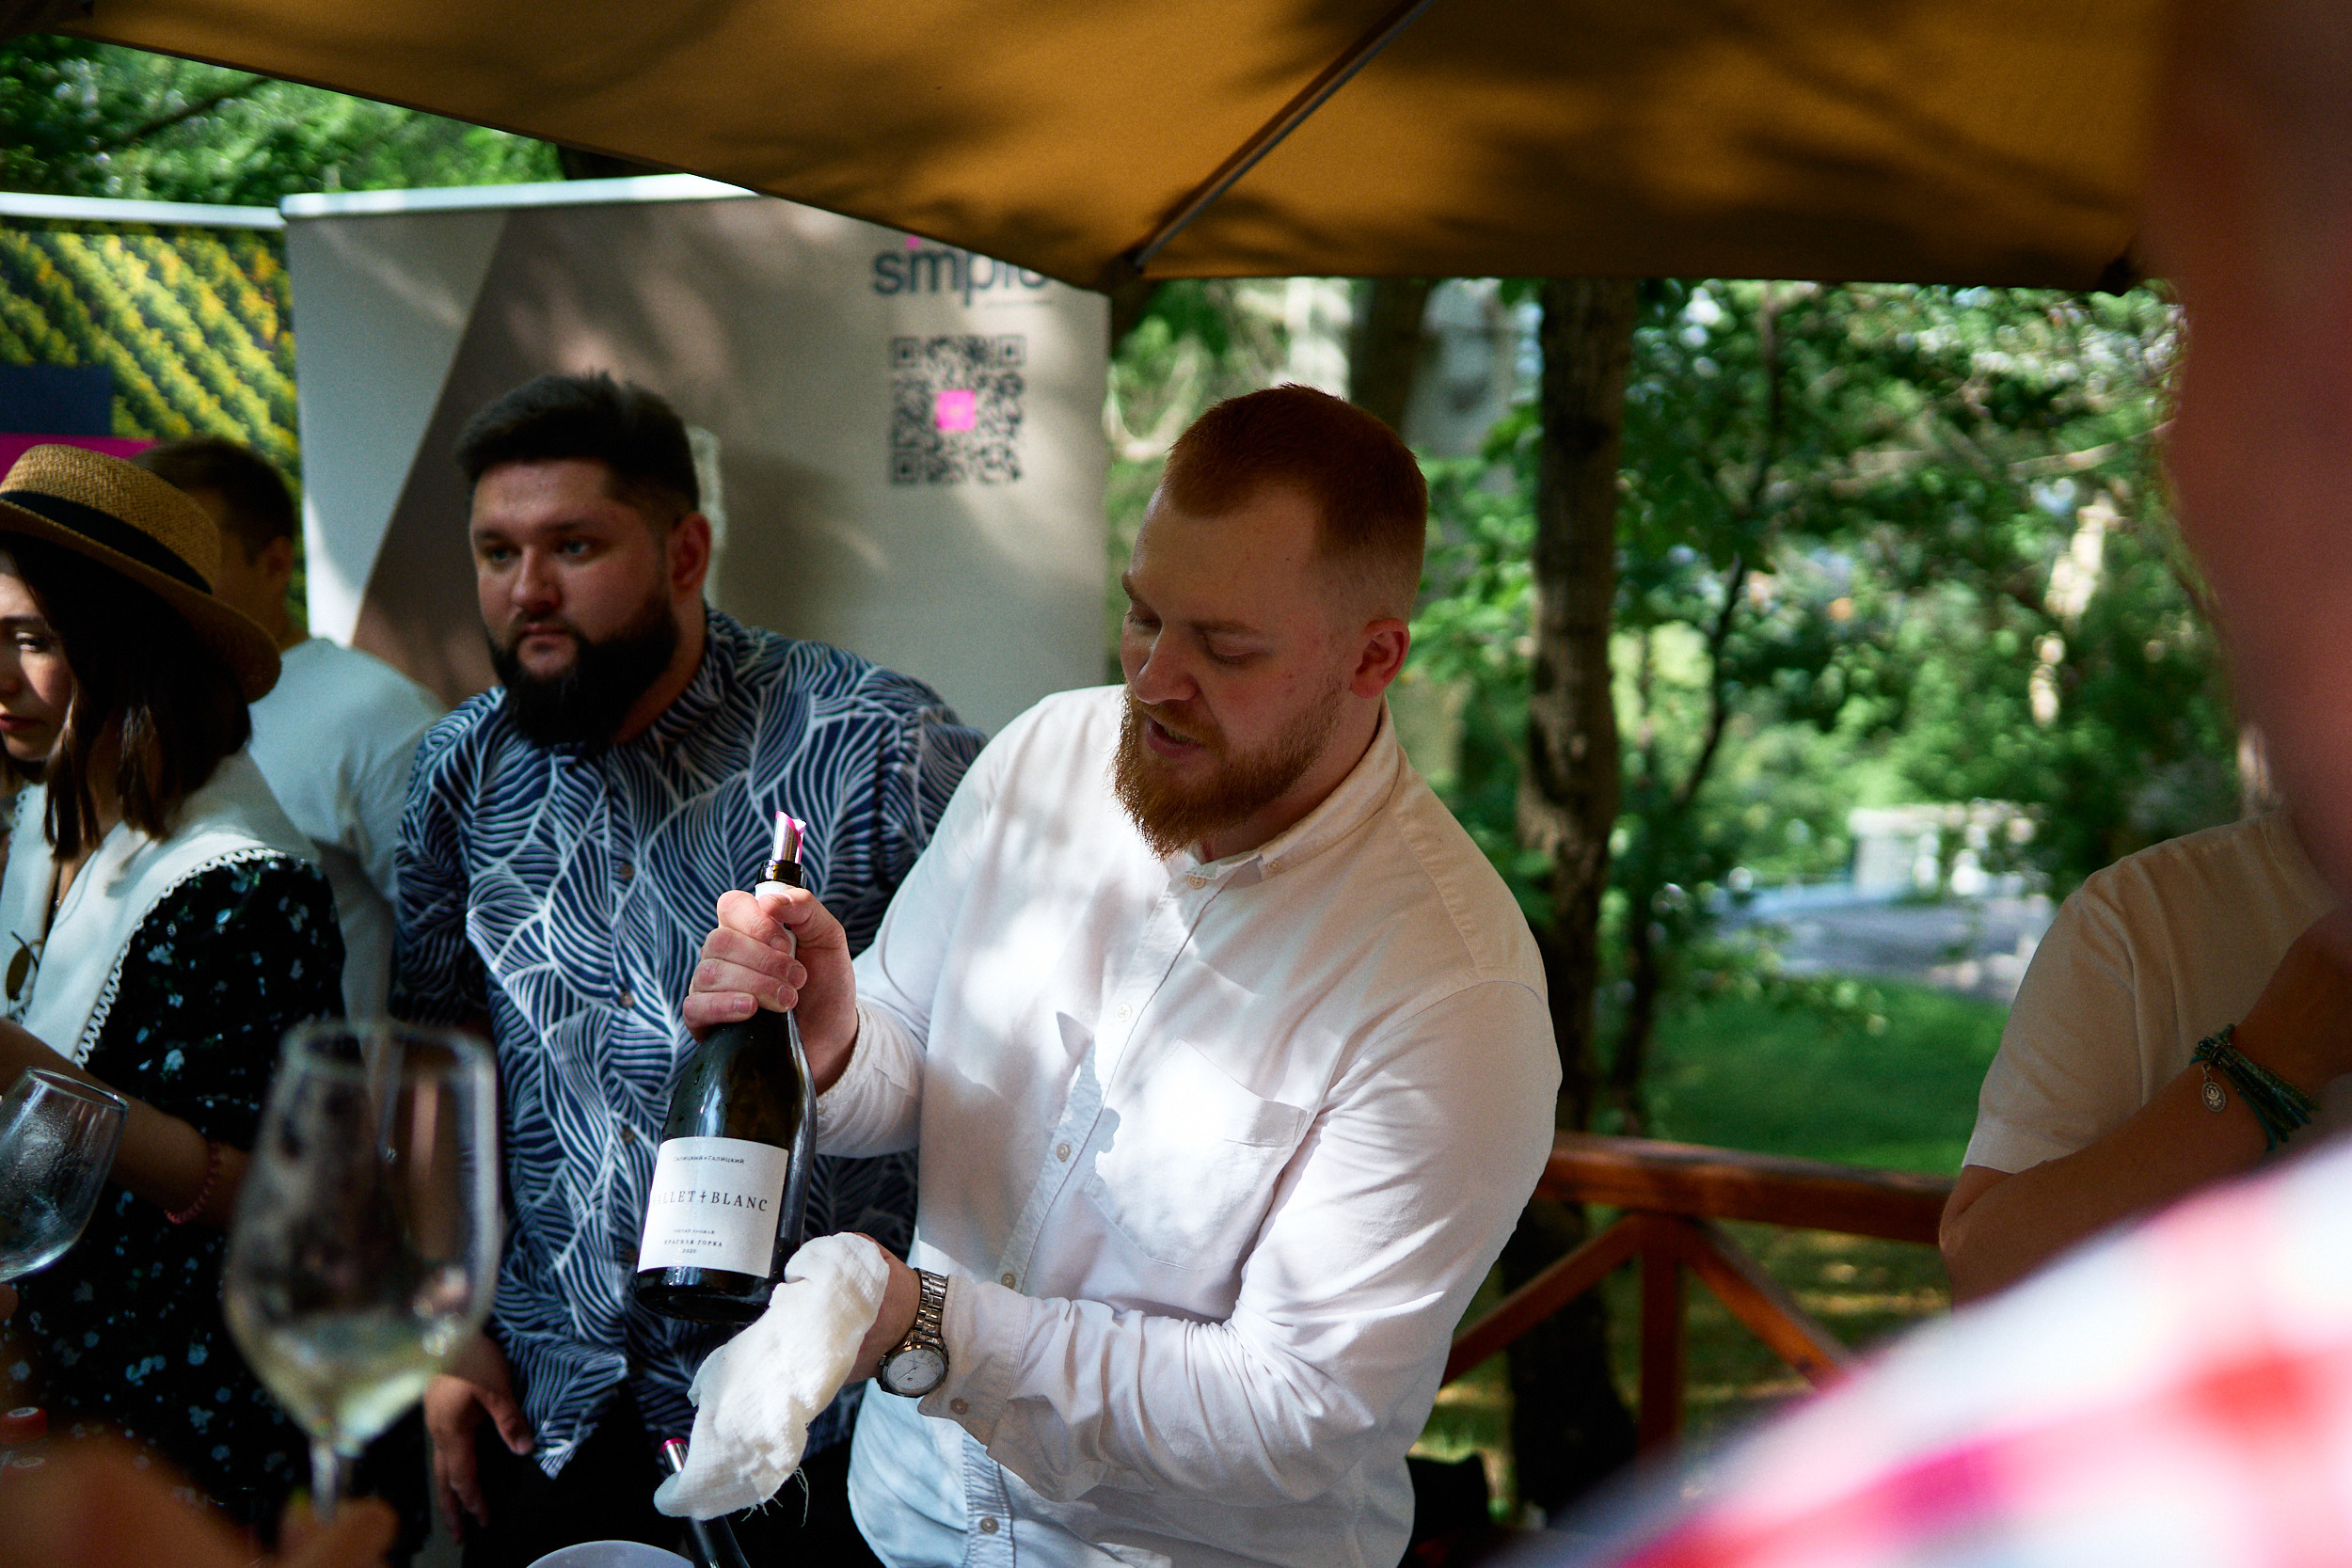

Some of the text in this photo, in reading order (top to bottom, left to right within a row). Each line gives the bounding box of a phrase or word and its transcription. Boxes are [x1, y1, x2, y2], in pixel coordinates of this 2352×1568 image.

[707, 1155, 745, 1164] ГАЛИЦКИЙ
[710, 1191, 769, 1212] BLANC
[697, 1239, 723, 1247] ГОРКА
